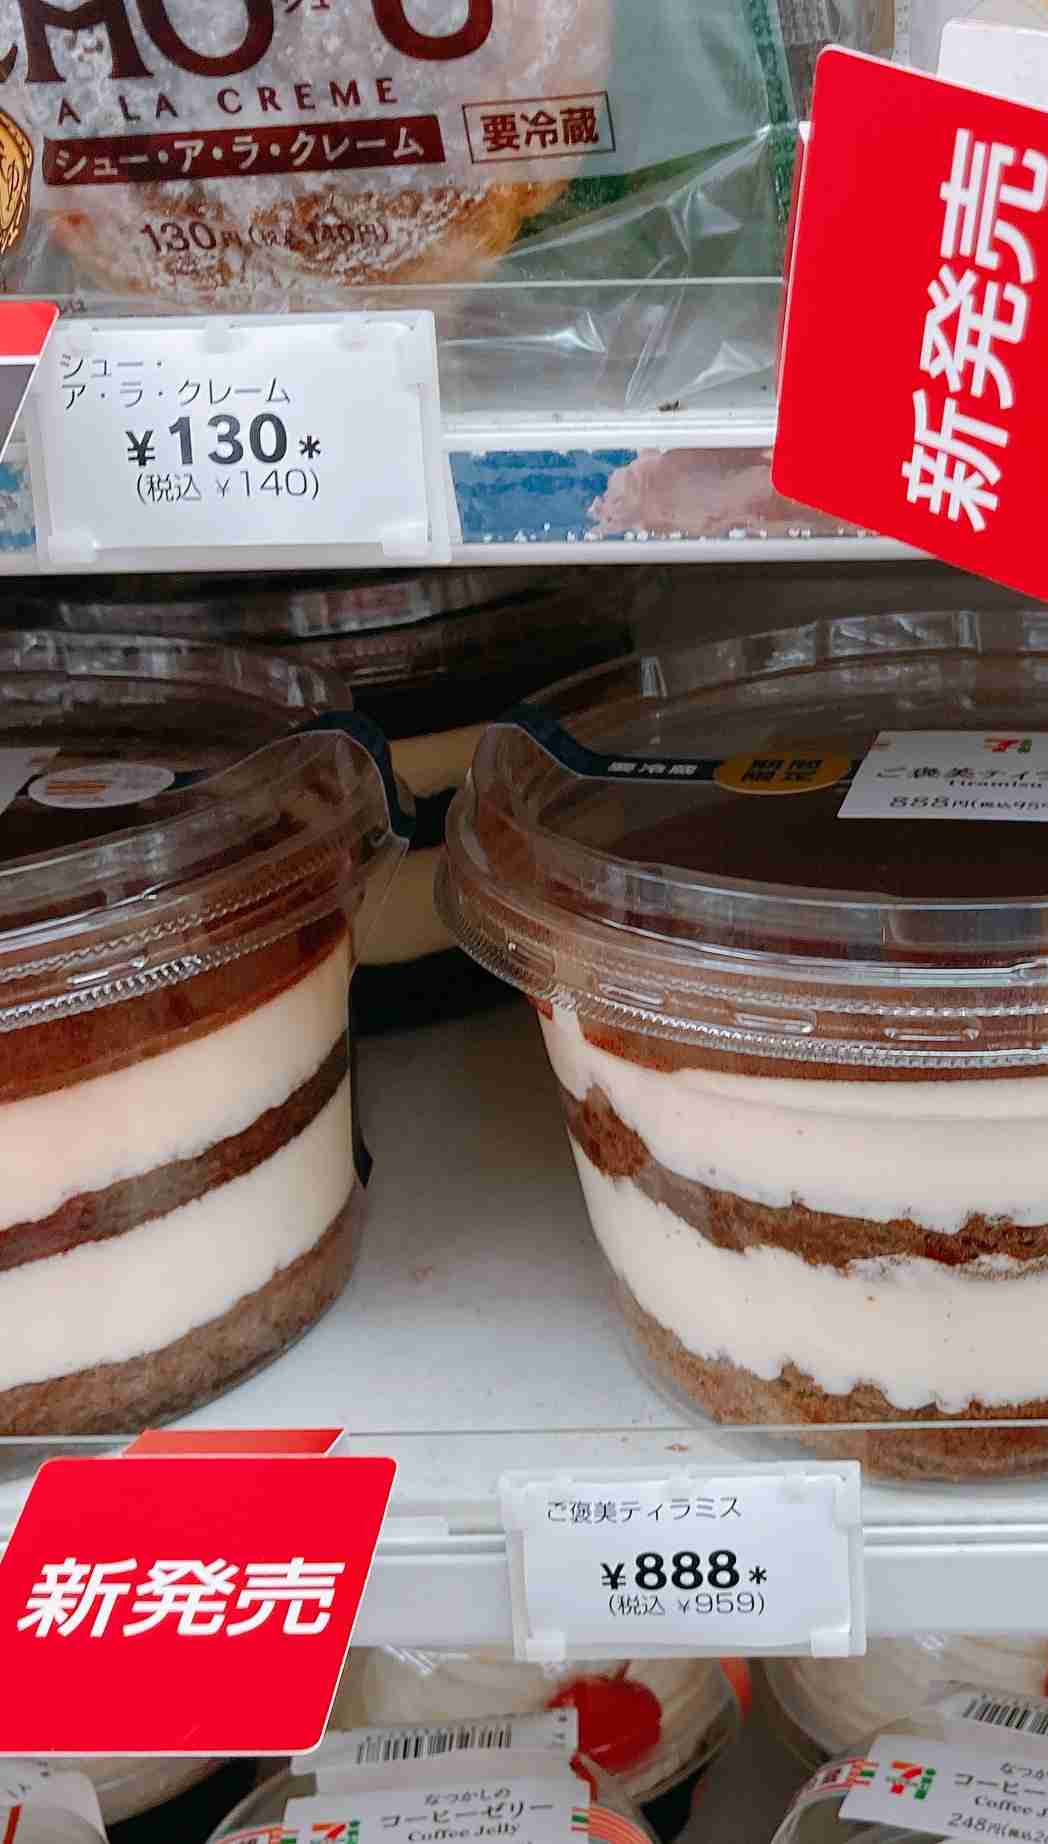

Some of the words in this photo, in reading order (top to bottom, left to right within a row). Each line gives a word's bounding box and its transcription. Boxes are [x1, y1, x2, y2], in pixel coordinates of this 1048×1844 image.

[0, 0, 494, 83] HOU
[58, 97, 81, 126] A
[118, 93, 179, 122] LA
[216, 77, 398, 115] CREME
[480, 107, 601, 153] 要冷蔵
[55, 126, 425, 181] シュー・ア・ラ・クレーム
[61, 377, 291, 411] ア・ラ・クレーム
[546, 1496, 743, 1526] ご褒美ティラミス
[16, 1556, 347, 1640] 新発売
[380, 1800, 554, 1829] コーヒーゼリー
[973, 1793, 1035, 1820] Coffee
[407, 1827, 471, 1843] Coffee
[474, 1822, 522, 1839] Jelly
